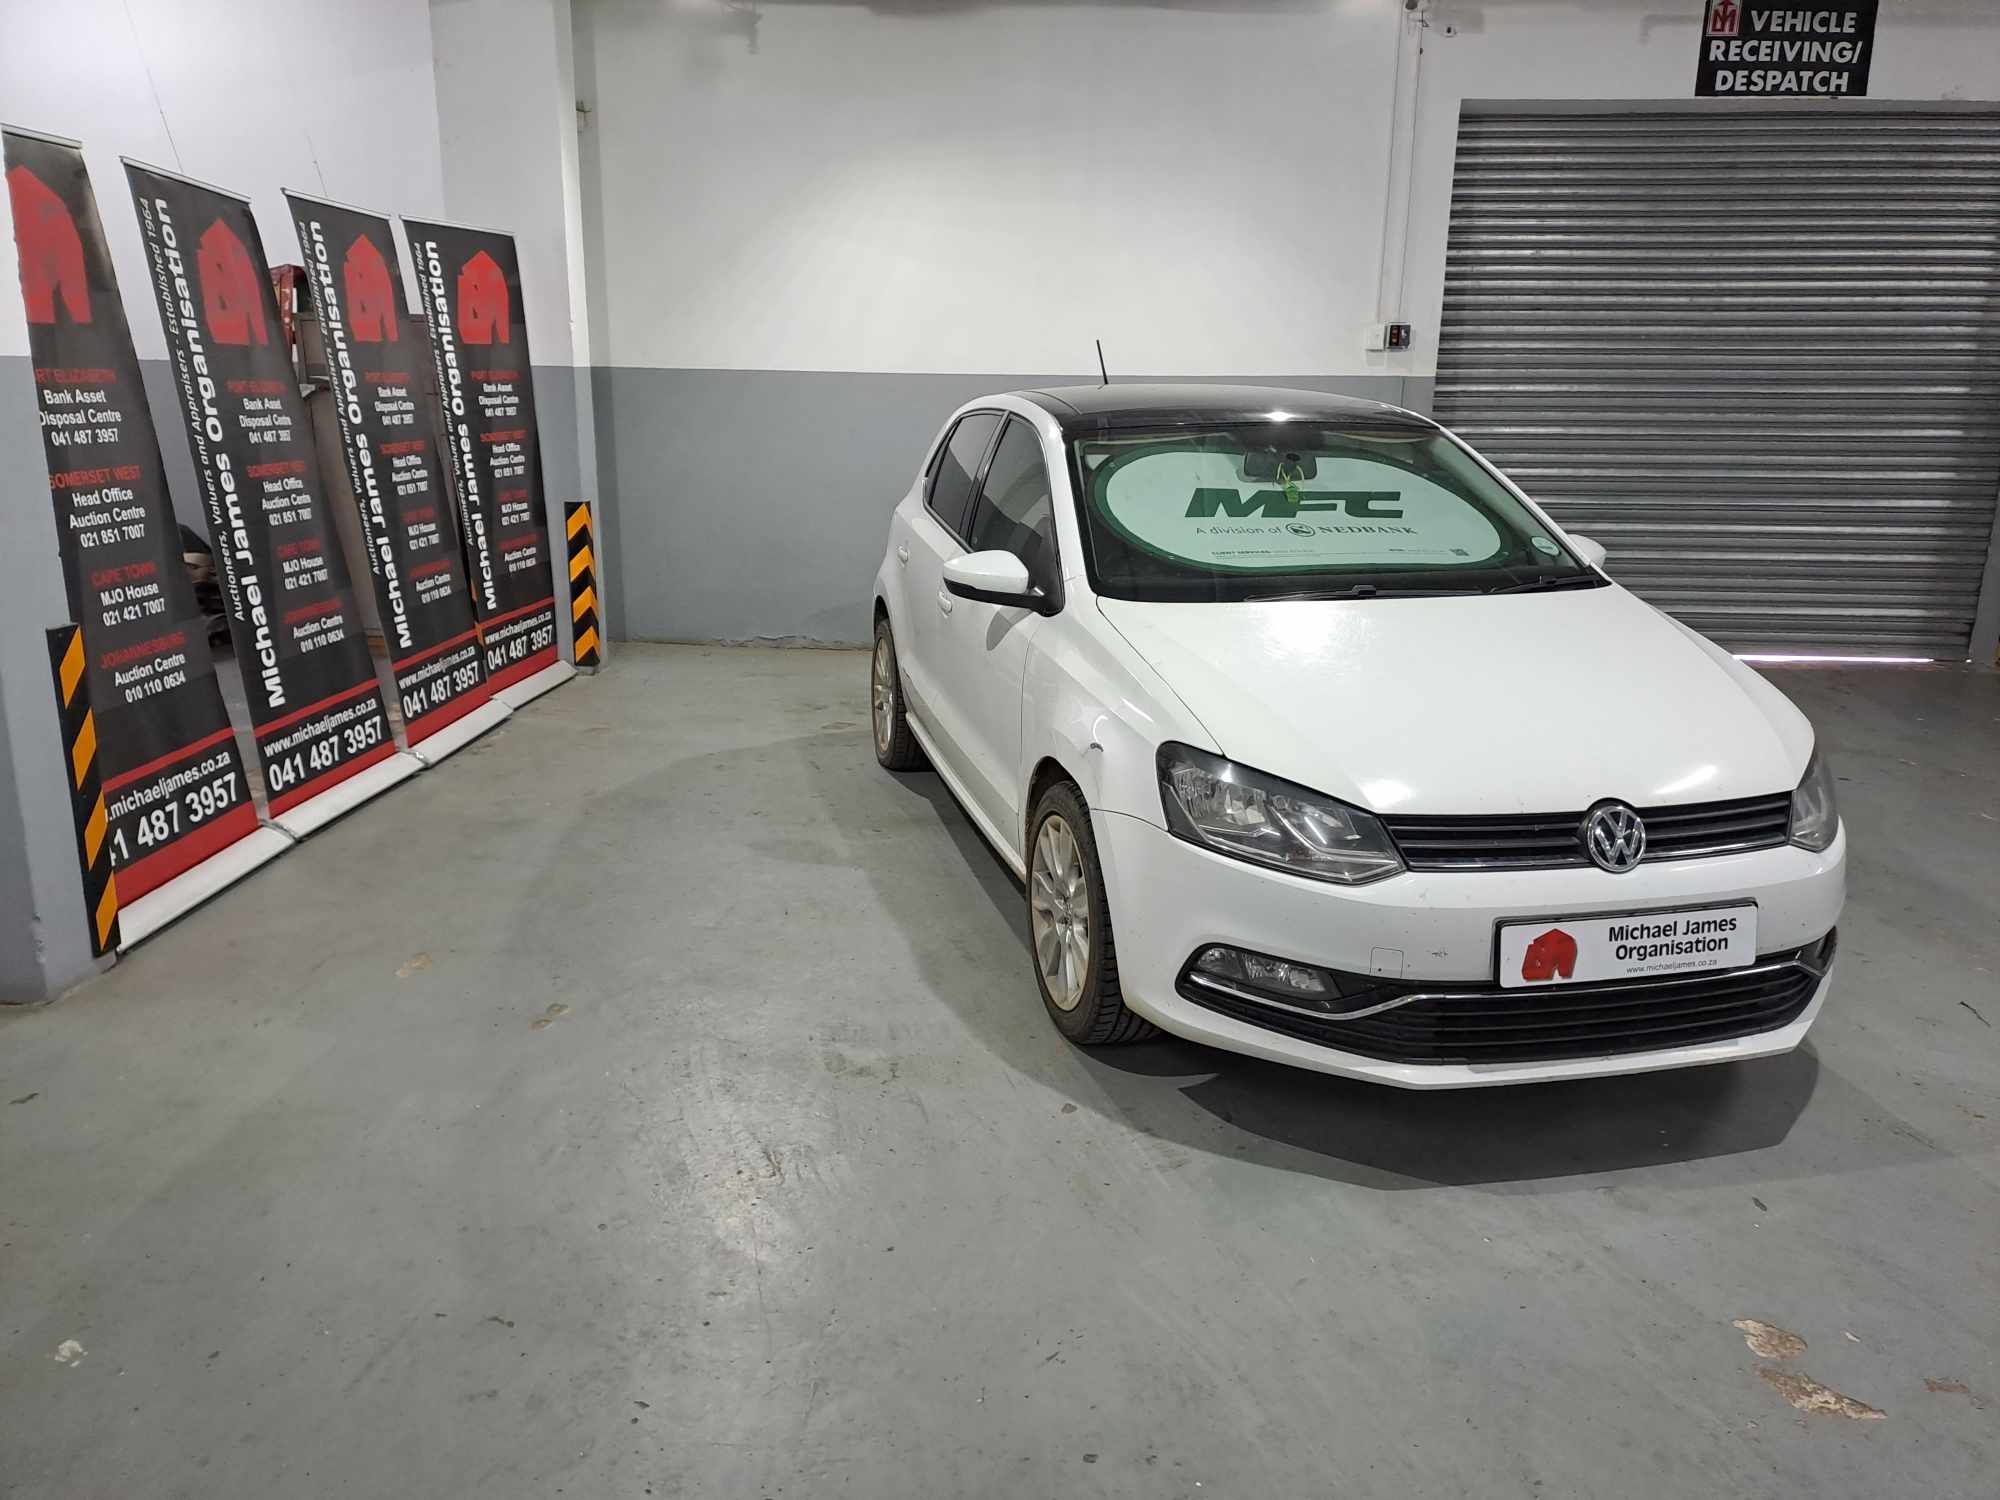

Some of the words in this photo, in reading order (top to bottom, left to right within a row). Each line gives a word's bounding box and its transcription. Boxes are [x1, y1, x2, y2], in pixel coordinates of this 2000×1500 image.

[1751, 10, 1857, 33] VEHICLE
[1709, 40, 1862, 64] RECEIVING/
[1715, 70, 1849, 92] DESPATCH
[139, 197, 157, 238] 1964
[152, 243, 178, 334] Established
[155, 198, 223, 443] Organisation
[310, 220, 362, 426] Organisation
[425, 241, 465, 416] Organisation
[43, 389, 73, 404] Bank
[75, 389, 107, 403] Asset
[177, 349, 202, 434] Appraisers
[39, 410, 85, 428] Disposal
[88, 409, 122, 422] Centre
[51, 431, 71, 446] 041
[73, 429, 92, 444] 487
[95, 428, 119, 443] 3957
[194, 435, 209, 466] and
[355, 432, 386, 528] James
[458, 424, 480, 506] James
[72, 489, 100, 507] Head
[102, 487, 133, 503] Office
[203, 468, 221, 525] Valuers
[215, 452, 254, 566] James
[1184, 487, 1403, 518] MFC
[69, 511, 111, 529] Auction
[113, 506, 146, 522] Centre
[1210, 525, 1265, 536] division
[1268, 526, 1281, 535] of
[1317, 525, 1418, 536] NEDBANK
[80, 532, 99, 547] 021
[101, 529, 121, 544] 851
[123, 524, 145, 540] 7007
[471, 513, 496, 610] Michael
[100, 588, 124, 606] MJO
[127, 583, 159, 600] House
[376, 536, 413, 649] Michael
[103, 611, 120, 626] 021
[123, 604, 142, 621] 421
[143, 598, 165, 615] 7007
[241, 574, 286, 709] Michael
[487, 647, 507, 671] 041
[509, 635, 527, 659] 487
[531, 624, 553, 650] 3957
[114, 665, 153, 686] Auction
[154, 653, 186, 672] Centre
[125, 687, 142, 703] 010
[144, 679, 162, 696] 110
[164, 670, 186, 689] 0634
[403, 690, 428, 718] 041
[431, 675, 451, 704] 487
[453, 660, 480, 692] 3957
[264, 698, 377, 758] www.michaeljames.co.za
[269, 752, 307, 792] 041
[310, 735, 340, 771] 487
[344, 715, 382, 754] 3957
[137, 801, 180, 847] 487
[185, 772, 237, 823] 3957
[1609, 920, 1678, 942] Michael
[1682, 917, 1737, 936] James
[1615, 936, 1729, 961] Organisation
[1626, 959, 1718, 974] www.michaeljames.co.za
